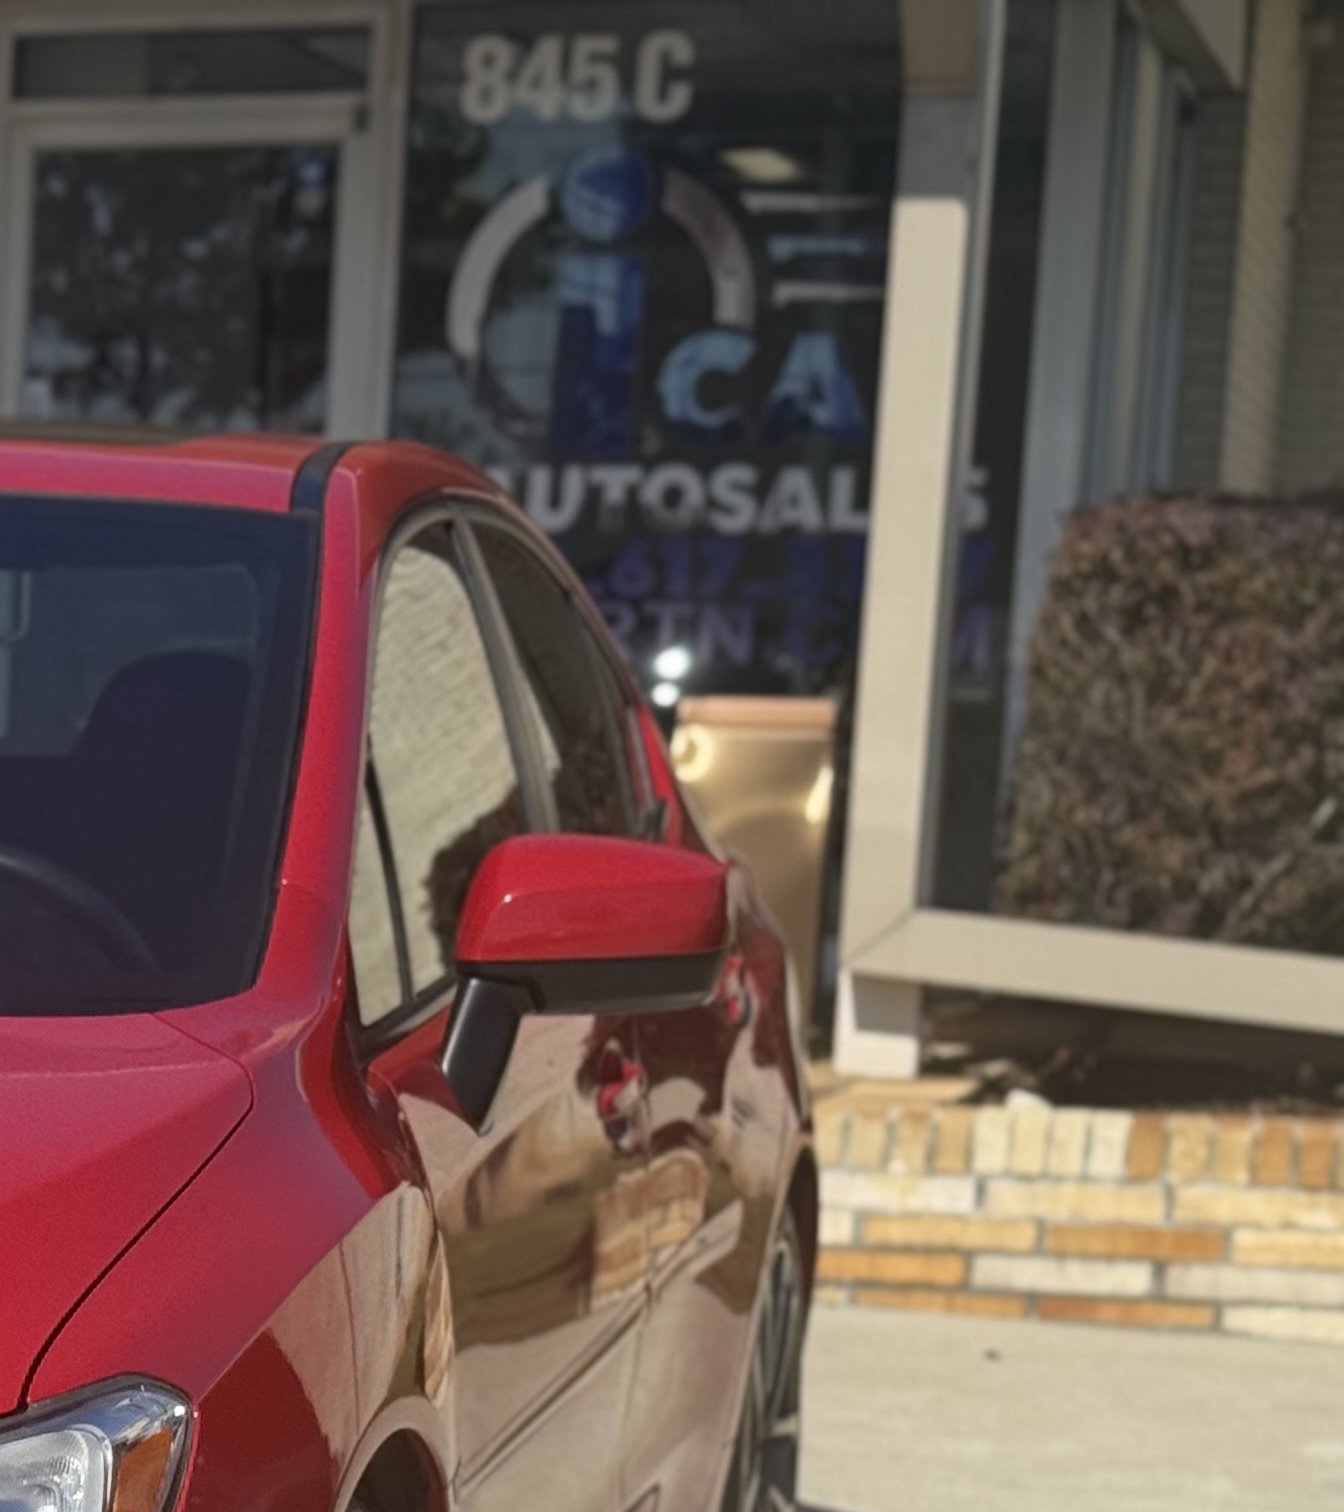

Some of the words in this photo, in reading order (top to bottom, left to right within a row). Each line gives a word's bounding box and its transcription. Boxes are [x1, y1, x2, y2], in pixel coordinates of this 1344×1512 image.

[461, 34, 620, 123] 845
[636, 30, 696, 124] C
[656, 328, 866, 442] CA
[489, 463, 987, 536] UTOSALS
